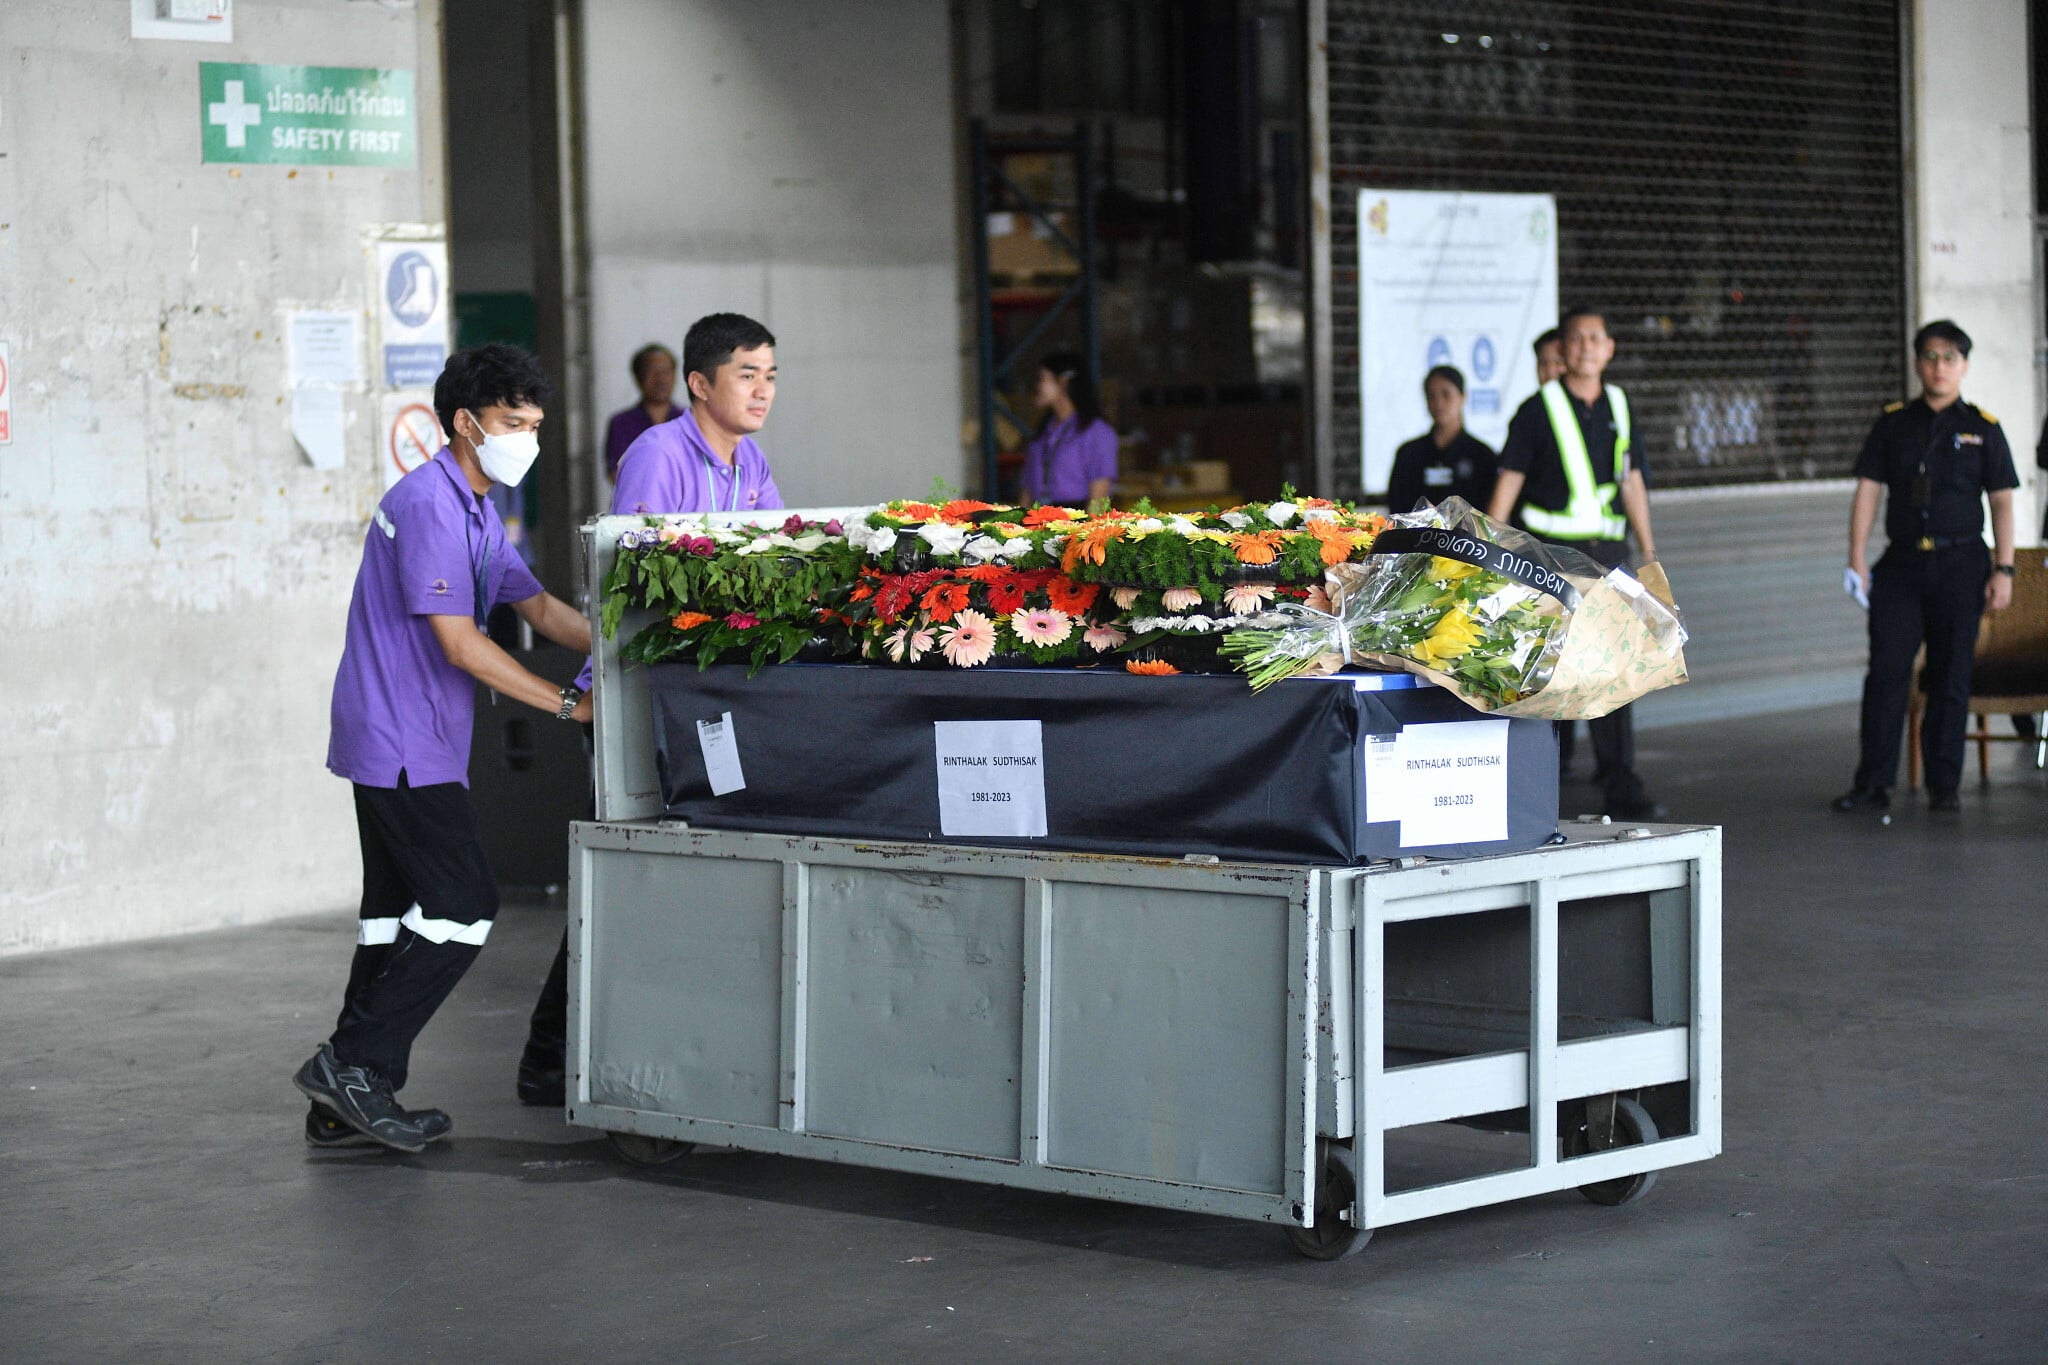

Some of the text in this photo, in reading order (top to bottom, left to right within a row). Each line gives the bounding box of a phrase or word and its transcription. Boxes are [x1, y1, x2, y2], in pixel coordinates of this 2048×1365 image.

[267, 84, 406, 117] ปลอดภัยไว้ก่อน
[272, 127, 402, 153] SAFETY FIRST
[1493, 552, 1565, 594] משפחות
[943, 756, 1037, 766] RINTHALAK SUDTHISAK
[1406, 758, 1451, 770] RINTHALAK
[1457, 755, 1501, 768] SUDTHISAK
[971, 792, 1011, 802] 1981-2023
[1434, 795, 1474, 807] 1981-2023
